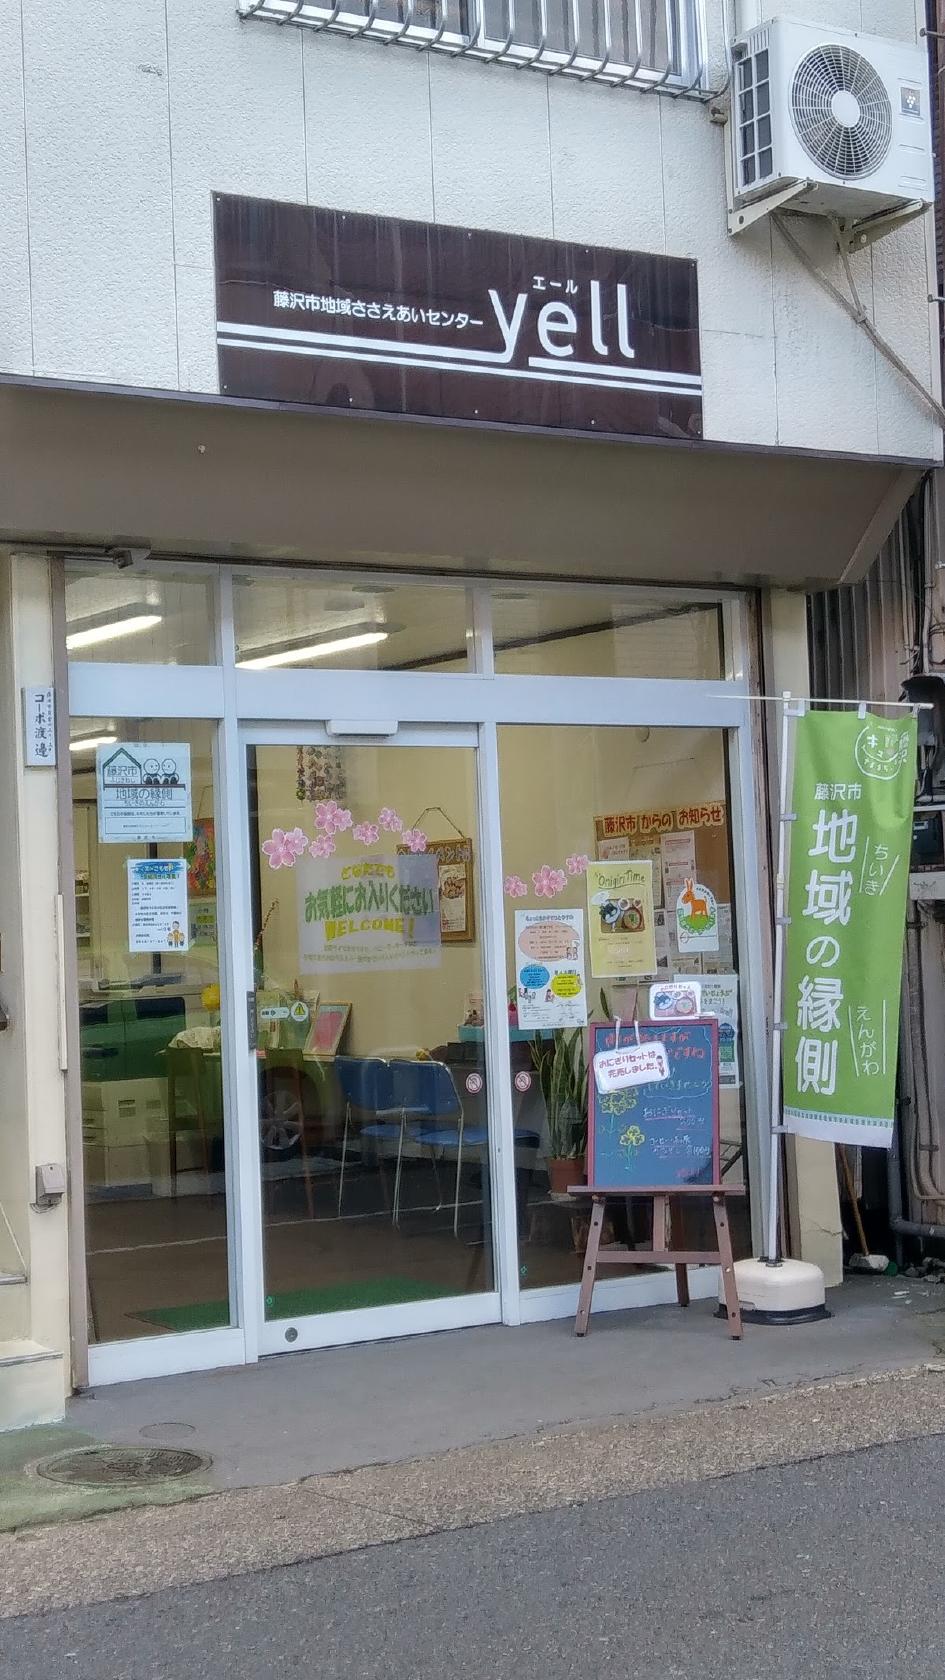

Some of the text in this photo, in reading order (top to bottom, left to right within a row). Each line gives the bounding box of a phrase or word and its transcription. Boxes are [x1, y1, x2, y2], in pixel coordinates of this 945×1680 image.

[533, 276, 578, 295] エール
[273, 290, 484, 329] 藤沢市地域ささえあいセンター
[488, 280, 635, 363] yell
[116, 788, 173, 801] 地域の縁側
[814, 782, 862, 802] 藤沢市
[603, 806, 722, 833] 藤沢市 からの お知らせ
[863, 844, 890, 897] ちいき
[304, 880, 434, 923] お気軽にお入りください
[795, 808, 858, 1096] 地域の縁側
[599, 1050, 657, 1069] おにぎりセットは
[856, 1005, 880, 1077] えんがわ
